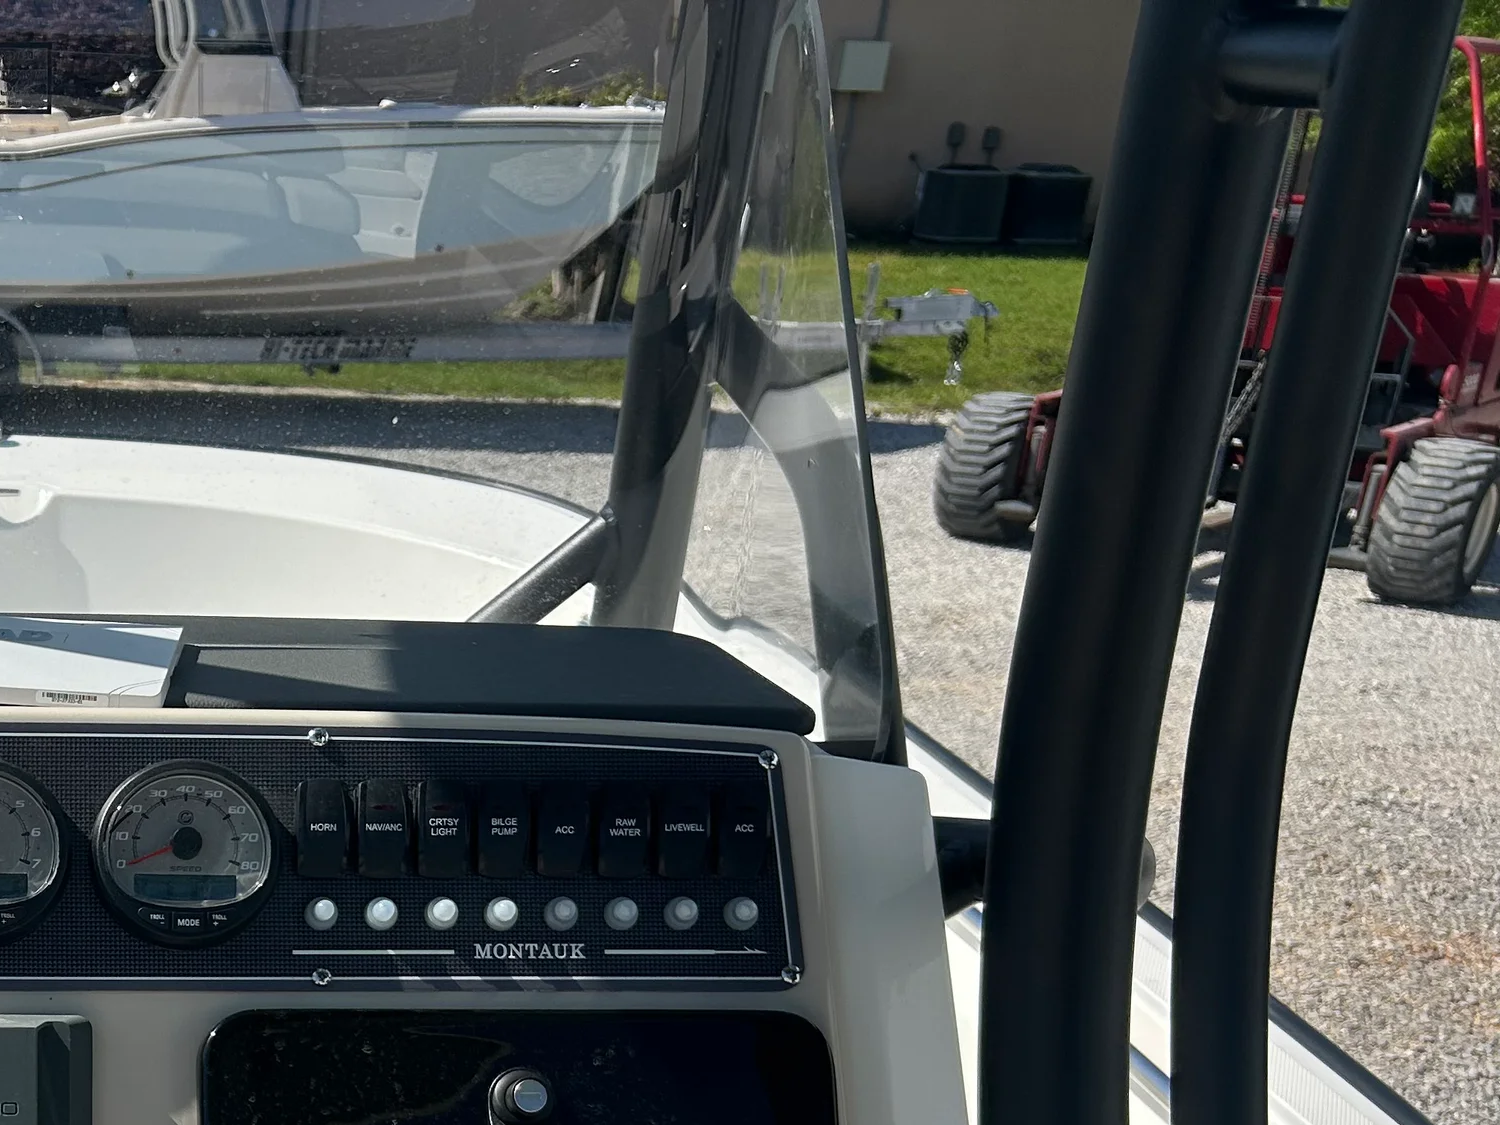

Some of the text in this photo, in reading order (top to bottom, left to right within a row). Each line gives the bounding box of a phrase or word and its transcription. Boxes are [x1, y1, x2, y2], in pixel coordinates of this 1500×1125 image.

[149, 790, 168, 798] 30
[15, 800, 26, 808] 5
[124, 805, 143, 813] 20
[228, 806, 246, 814] 60
[429, 818, 459, 826] CRTSY
[491, 818, 517, 826] BILGE
[615, 818, 636, 827] RAW
[310, 823, 337, 831] HORN
[366, 823, 402, 831] NAV/ANC
[491, 827, 517, 836] PUMP
[555, 825, 574, 834] ACC
[664, 823, 704, 832] LIVEWELL
[735, 824, 754, 833] ACC
[31, 828, 41, 837] 6
[115, 832, 129, 841] 10
[431, 828, 457, 836] LIGHT
[609, 828, 641, 837] WATER
[240, 833, 259, 842] 70
[32, 859, 42, 869] 7
[116, 860, 126, 869] 0
[240, 861, 260, 870] 80
[177, 919, 200, 927] MODE
[474, 943, 586, 959] MONTAUK
